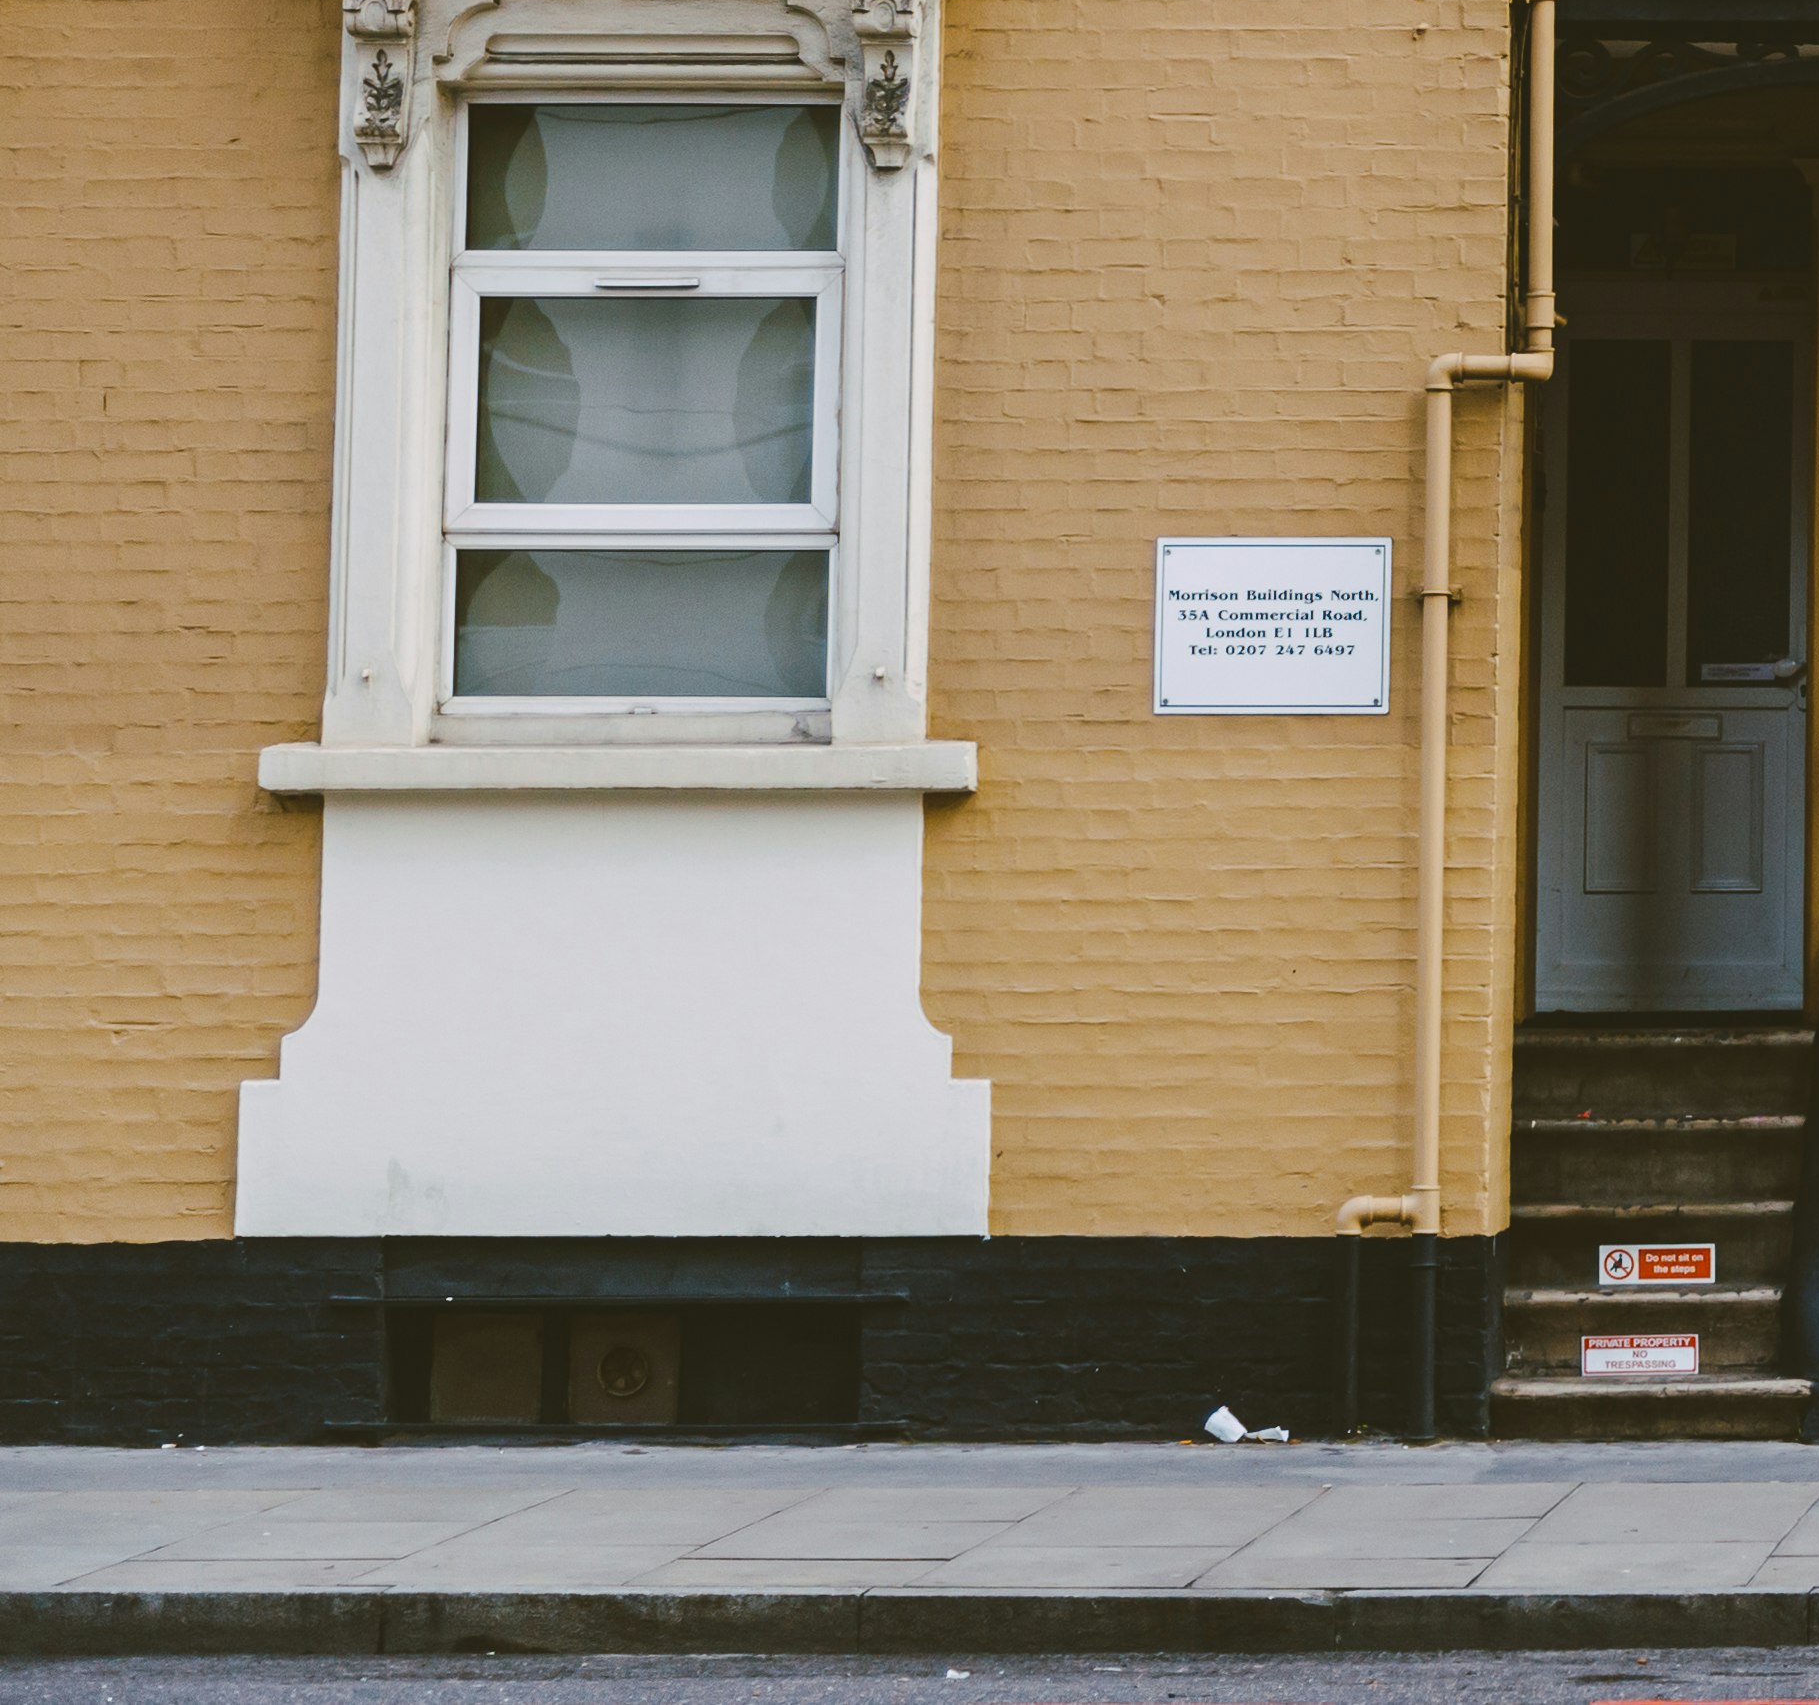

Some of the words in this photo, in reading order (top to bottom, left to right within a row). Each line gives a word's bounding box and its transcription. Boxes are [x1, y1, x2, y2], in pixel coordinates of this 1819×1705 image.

[1169, 590, 1238, 601] Morrison
[1247, 590, 1323, 604] Buildings
[1331, 590, 1379, 602] North,
[1178, 610, 1209, 620] 35A
[1218, 610, 1314, 620] Commercial
[1322, 610, 1367, 622] Road,
[1206, 628, 1266, 638] London
[1275, 628, 1292, 638] E1
[1305, 628, 1332, 638] 1LB
[1189, 645, 1217, 655] Tel:
[1226, 645, 1266, 655] 0207
[1276, 645, 1305, 655] 247
[1314, 645, 1354, 655] 6497
[1646, 1254, 1659, 1262] Do
[1661, 1254, 1676, 1262] not
[1654, 1265, 1668, 1273] the
[1671, 1266, 1696, 1274] steps
[1589, 1339, 1629, 1347] PRIVATE
[1633, 1338, 1690, 1347] PROPERTY
[1633, 1350, 1647, 1358] NO
[1605, 1360, 1676, 1369] TRESPASSING
